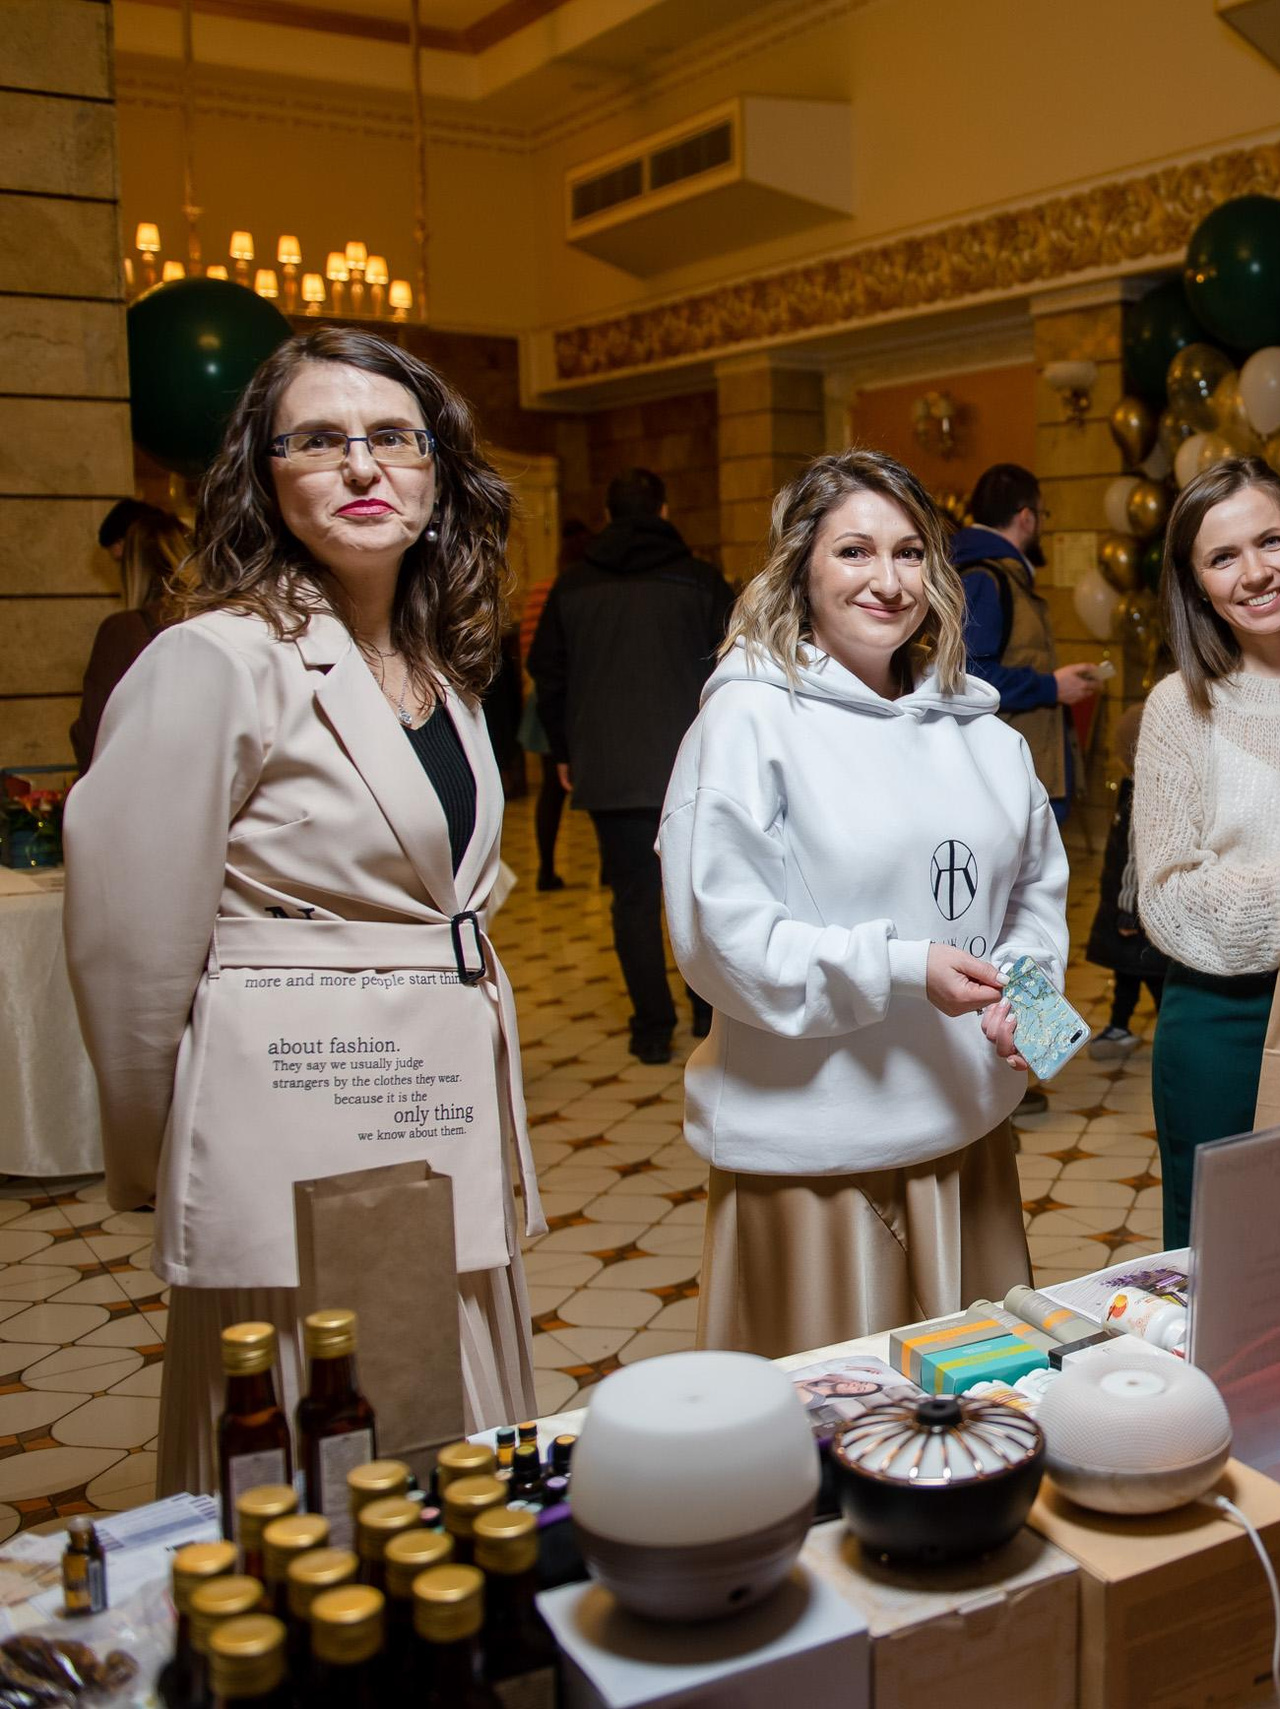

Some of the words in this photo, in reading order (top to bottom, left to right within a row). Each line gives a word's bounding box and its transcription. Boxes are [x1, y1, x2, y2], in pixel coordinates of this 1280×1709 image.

[245, 976, 281, 988] more
[286, 973, 314, 986] and
[320, 975, 356, 986] more
[361, 974, 404, 989] people
[409, 974, 436, 985] start
[440, 971, 468, 985] thin
[268, 1038, 323, 1055] about
[329, 1037, 400, 1053] fashion.
[272, 1060, 302, 1073] They
[306, 1062, 326, 1073] say
[330, 1062, 346, 1070] we
[350, 1058, 392, 1071] usually
[395, 1057, 424, 1070] judge
[272, 1078, 329, 1090] strangers
[334, 1076, 348, 1089] by
[352, 1076, 370, 1087] the
[374, 1074, 412, 1086] clothes
[415, 1074, 435, 1086] they
[438, 1074, 462, 1083] wear.
[334, 1093, 383, 1105] because
[386, 1092, 395, 1103] it
[398, 1092, 407, 1103] is
[411, 1091, 427, 1102] the
[394, 1105, 430, 1126] only
[434, 1103, 474, 1123] thing
[358, 1131, 373, 1141] we
[377, 1129, 406, 1140] know
[409, 1127, 438, 1139] about
[441, 1126, 466, 1136] them.
